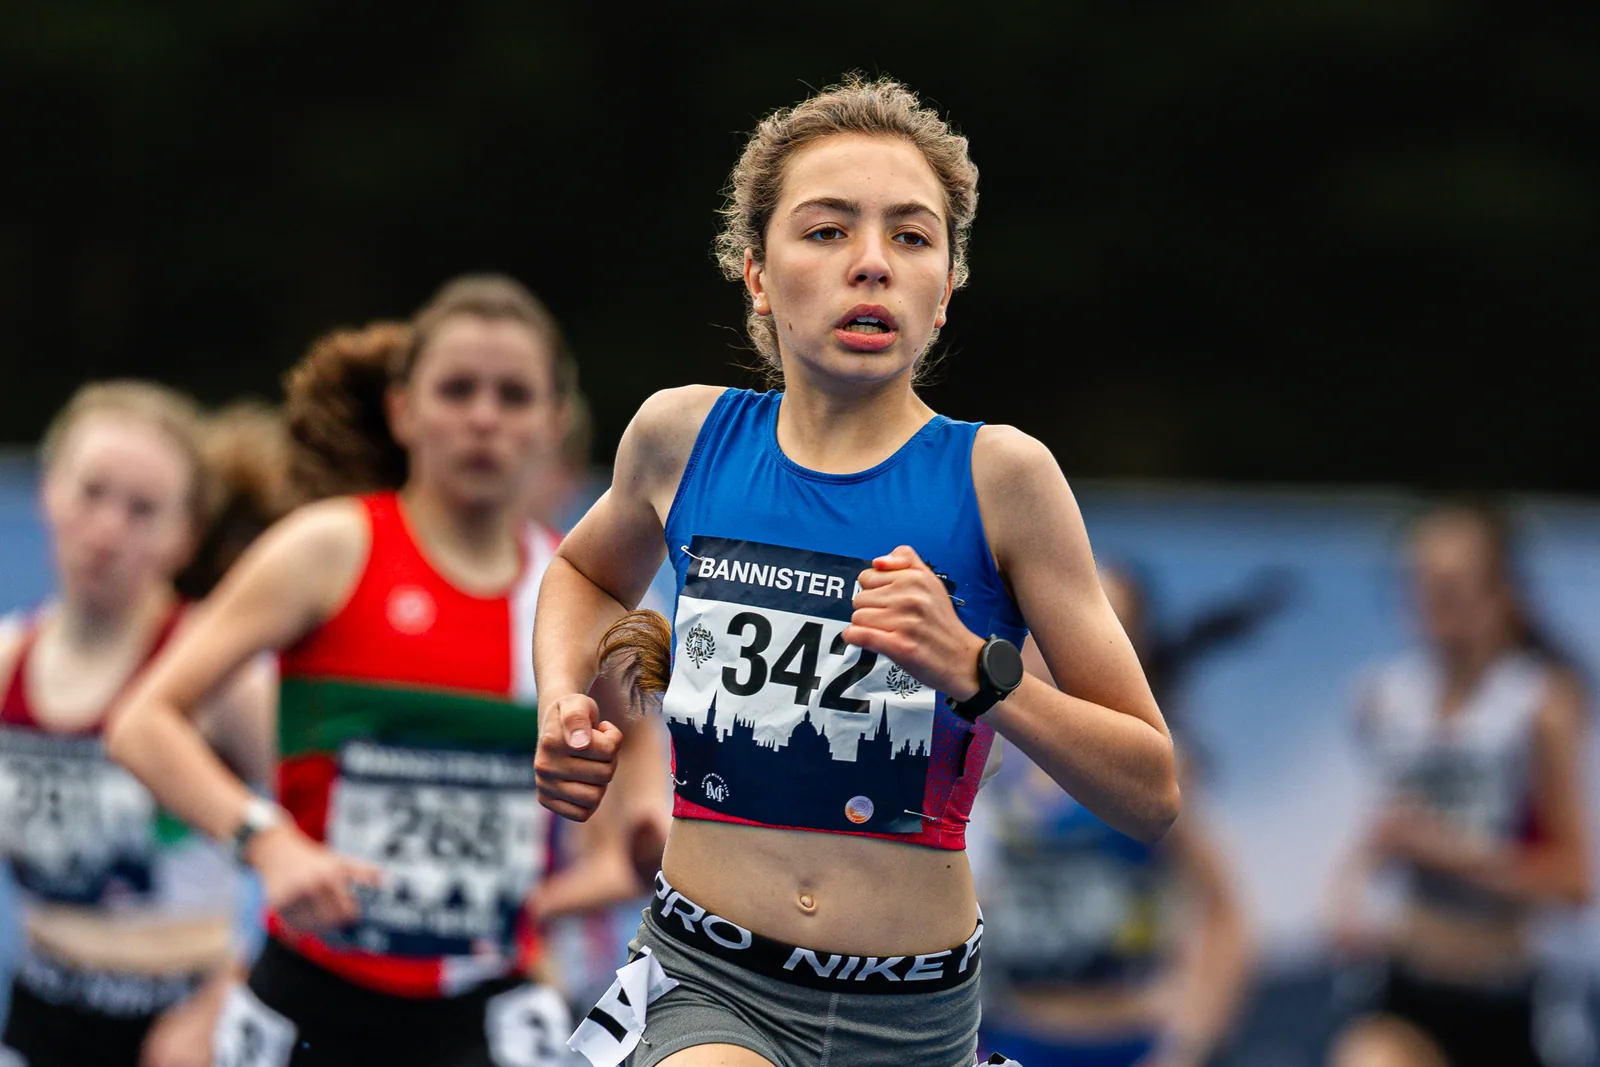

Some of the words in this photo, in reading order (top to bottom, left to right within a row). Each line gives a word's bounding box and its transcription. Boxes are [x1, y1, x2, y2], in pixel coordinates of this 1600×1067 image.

[698, 557, 845, 599] BANNISTER
[721, 612, 879, 714] 342
[783, 947, 952, 982] NIKE
